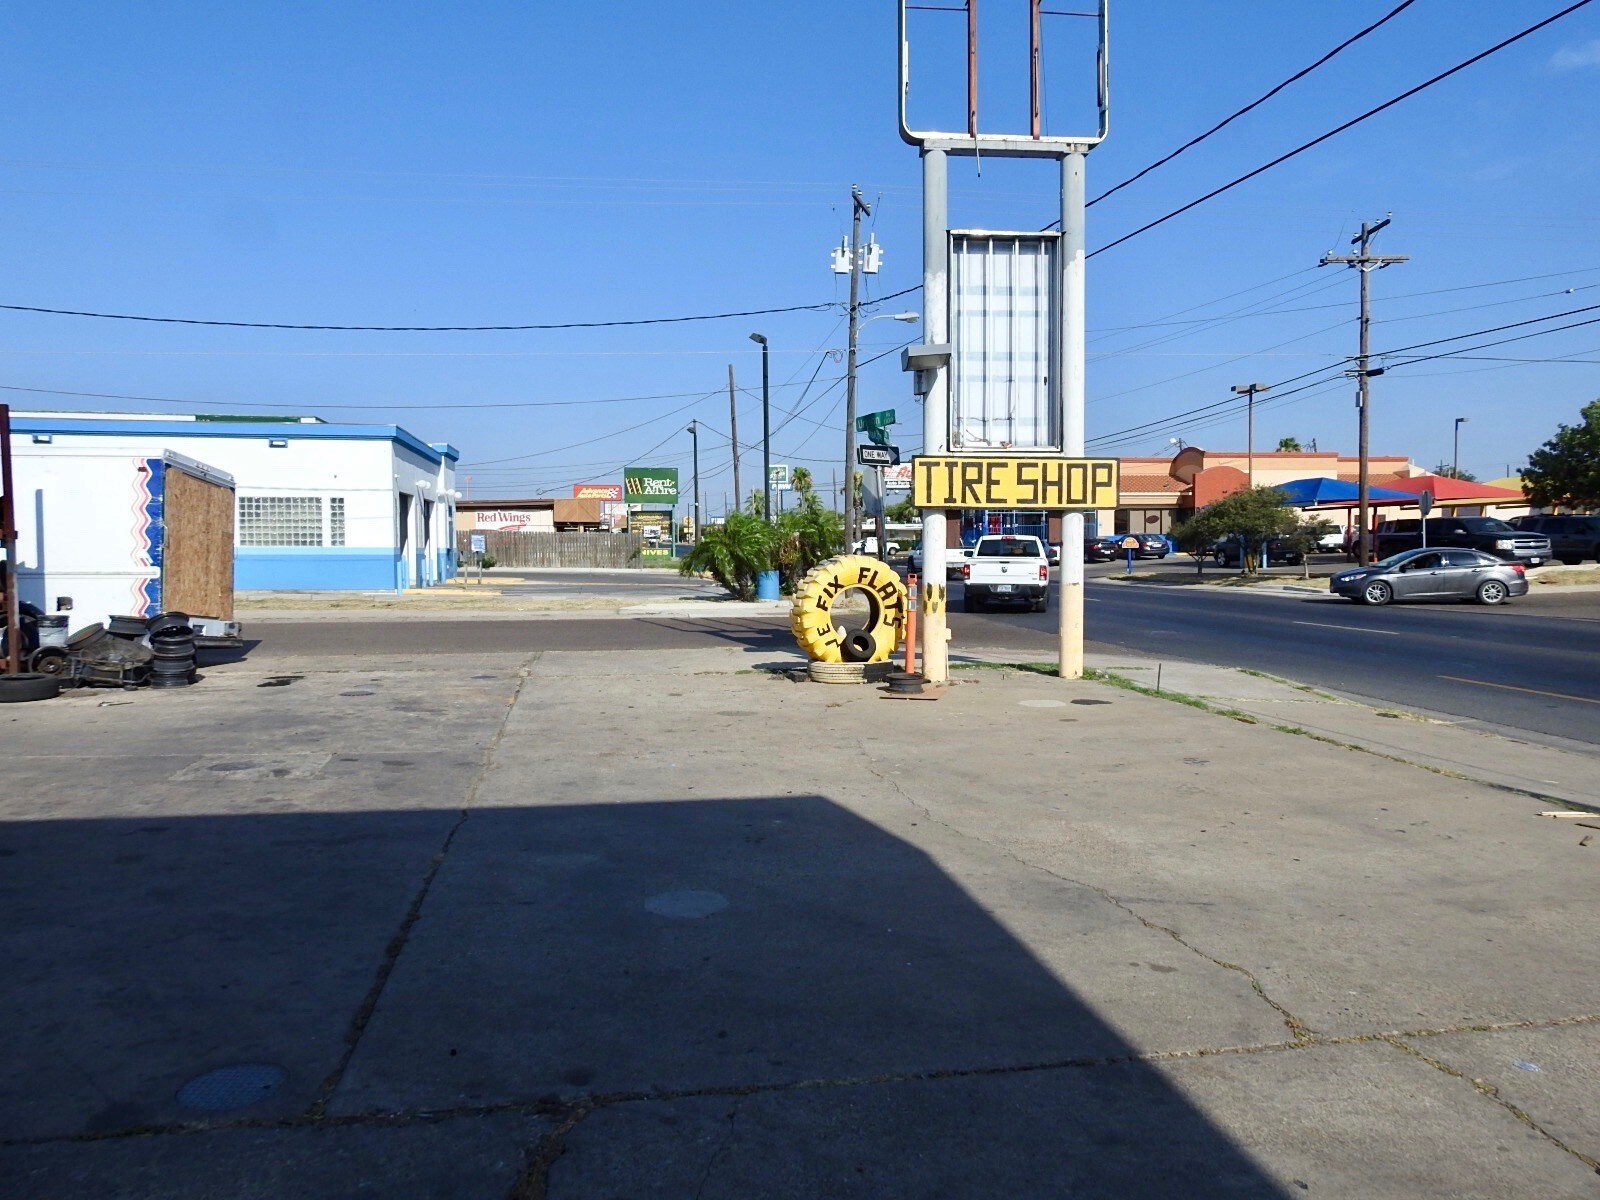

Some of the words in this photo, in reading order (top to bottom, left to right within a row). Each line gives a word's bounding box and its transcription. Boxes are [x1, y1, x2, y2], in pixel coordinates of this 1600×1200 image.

[863, 450, 875, 459] ONE
[876, 451, 888, 459] WAY
[919, 461, 1009, 504] TIRE
[1016, 462, 1113, 505] SHOP
[476, 512, 497, 523] Red
[497, 511, 531, 526] Wings
[816, 575, 844, 612] FIX
